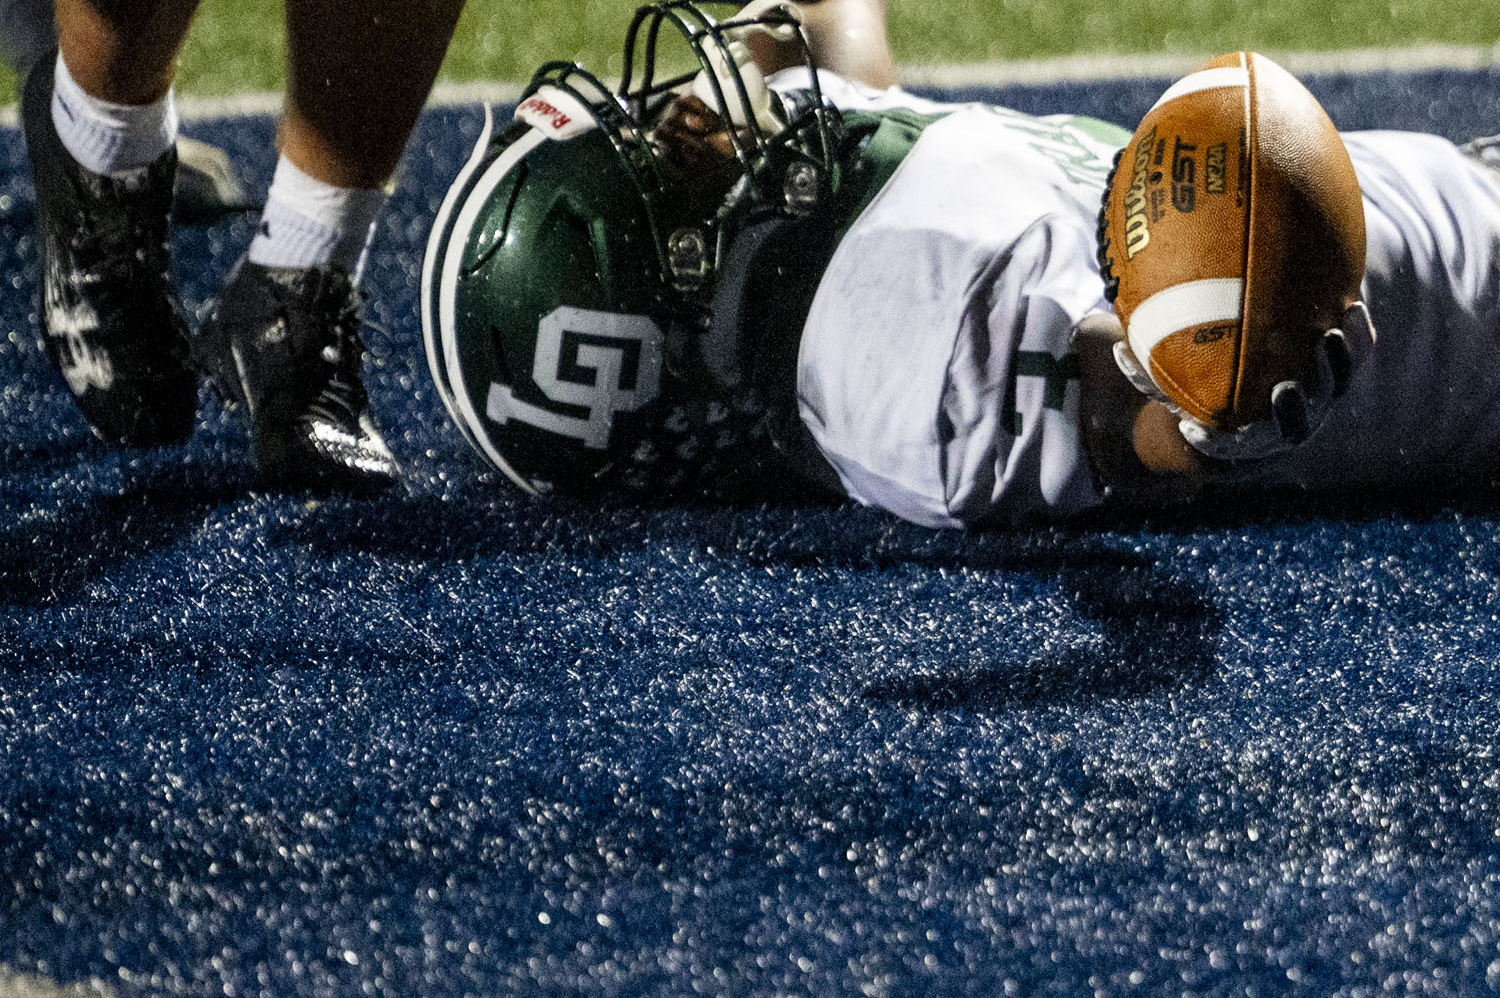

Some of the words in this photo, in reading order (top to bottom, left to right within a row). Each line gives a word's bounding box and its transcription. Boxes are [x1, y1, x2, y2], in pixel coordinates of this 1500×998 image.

[1123, 124, 1159, 263] Wilson
[1171, 135, 1197, 214] GST
[1206, 144, 1226, 193] NCAA
